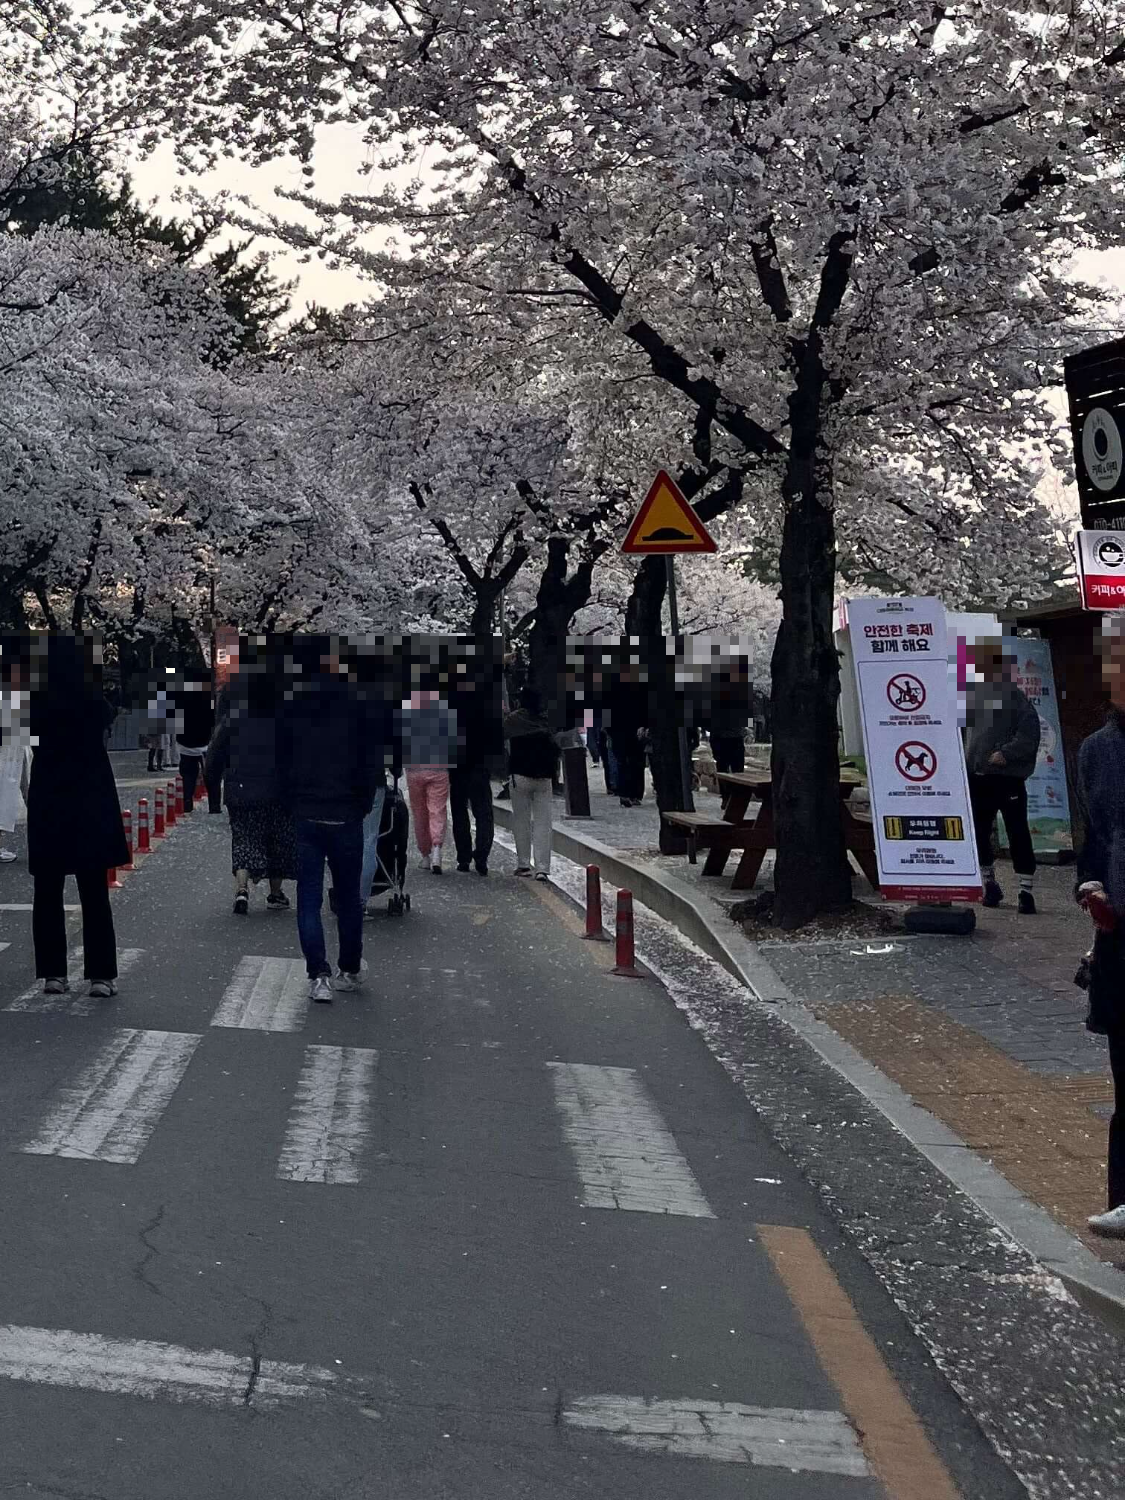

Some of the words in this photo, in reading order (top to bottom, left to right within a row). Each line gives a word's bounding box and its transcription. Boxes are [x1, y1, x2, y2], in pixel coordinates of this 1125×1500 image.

[863, 624, 903, 638] 안전한
[906, 623, 934, 637] 축제
[870, 639, 899, 653] 함께
[901, 638, 931, 652] 해요
